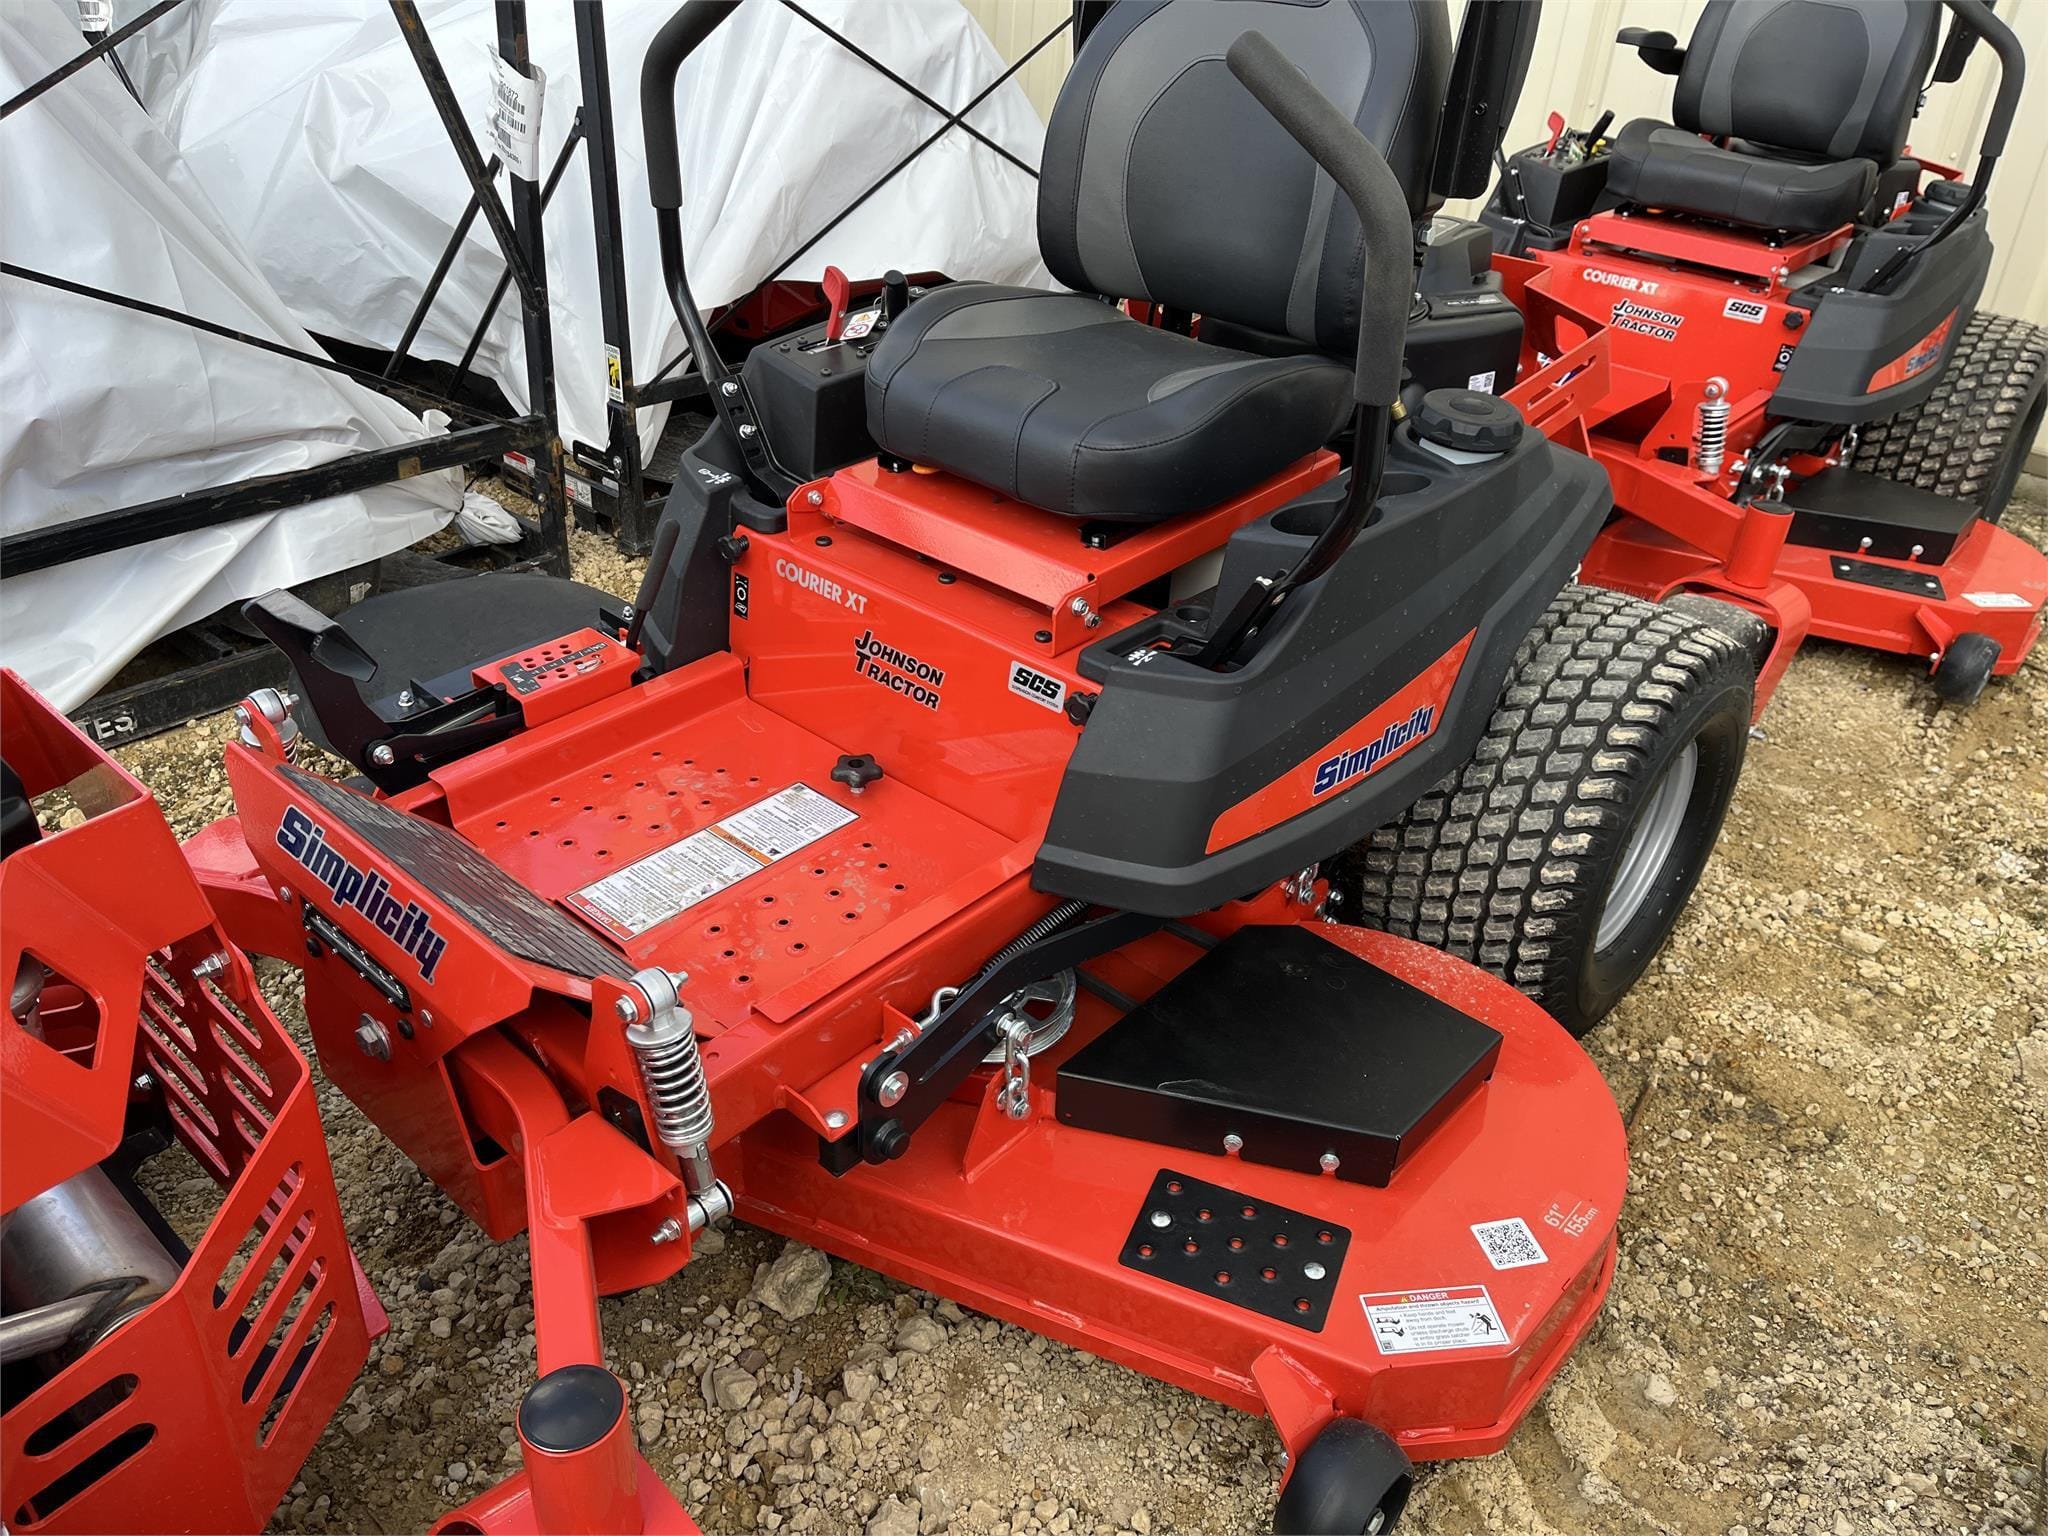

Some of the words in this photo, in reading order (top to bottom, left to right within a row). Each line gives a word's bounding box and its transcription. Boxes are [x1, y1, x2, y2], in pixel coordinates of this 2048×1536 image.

[1582, 268, 1638, 291] COURIER
[1638, 280, 1660, 296] XT
[1613, 299, 1683, 326] JOHNSON
[1728, 302, 1763, 316] SCS
[1610, 313, 1676, 340] TRACTOR
[775, 558, 842, 604] COURIER
[844, 590, 868, 615] XT
[855, 630, 945, 687] JOHNSON
[855, 651, 941, 711] TRACTOR
[1013, 667, 1061, 699] SCS
[1312, 704, 1435, 797] Simplicity
[276, 804, 449, 982] Simplicity
[584, 903, 613, 924] DANGER
[1408, 1292, 1449, 1301] DANGER
